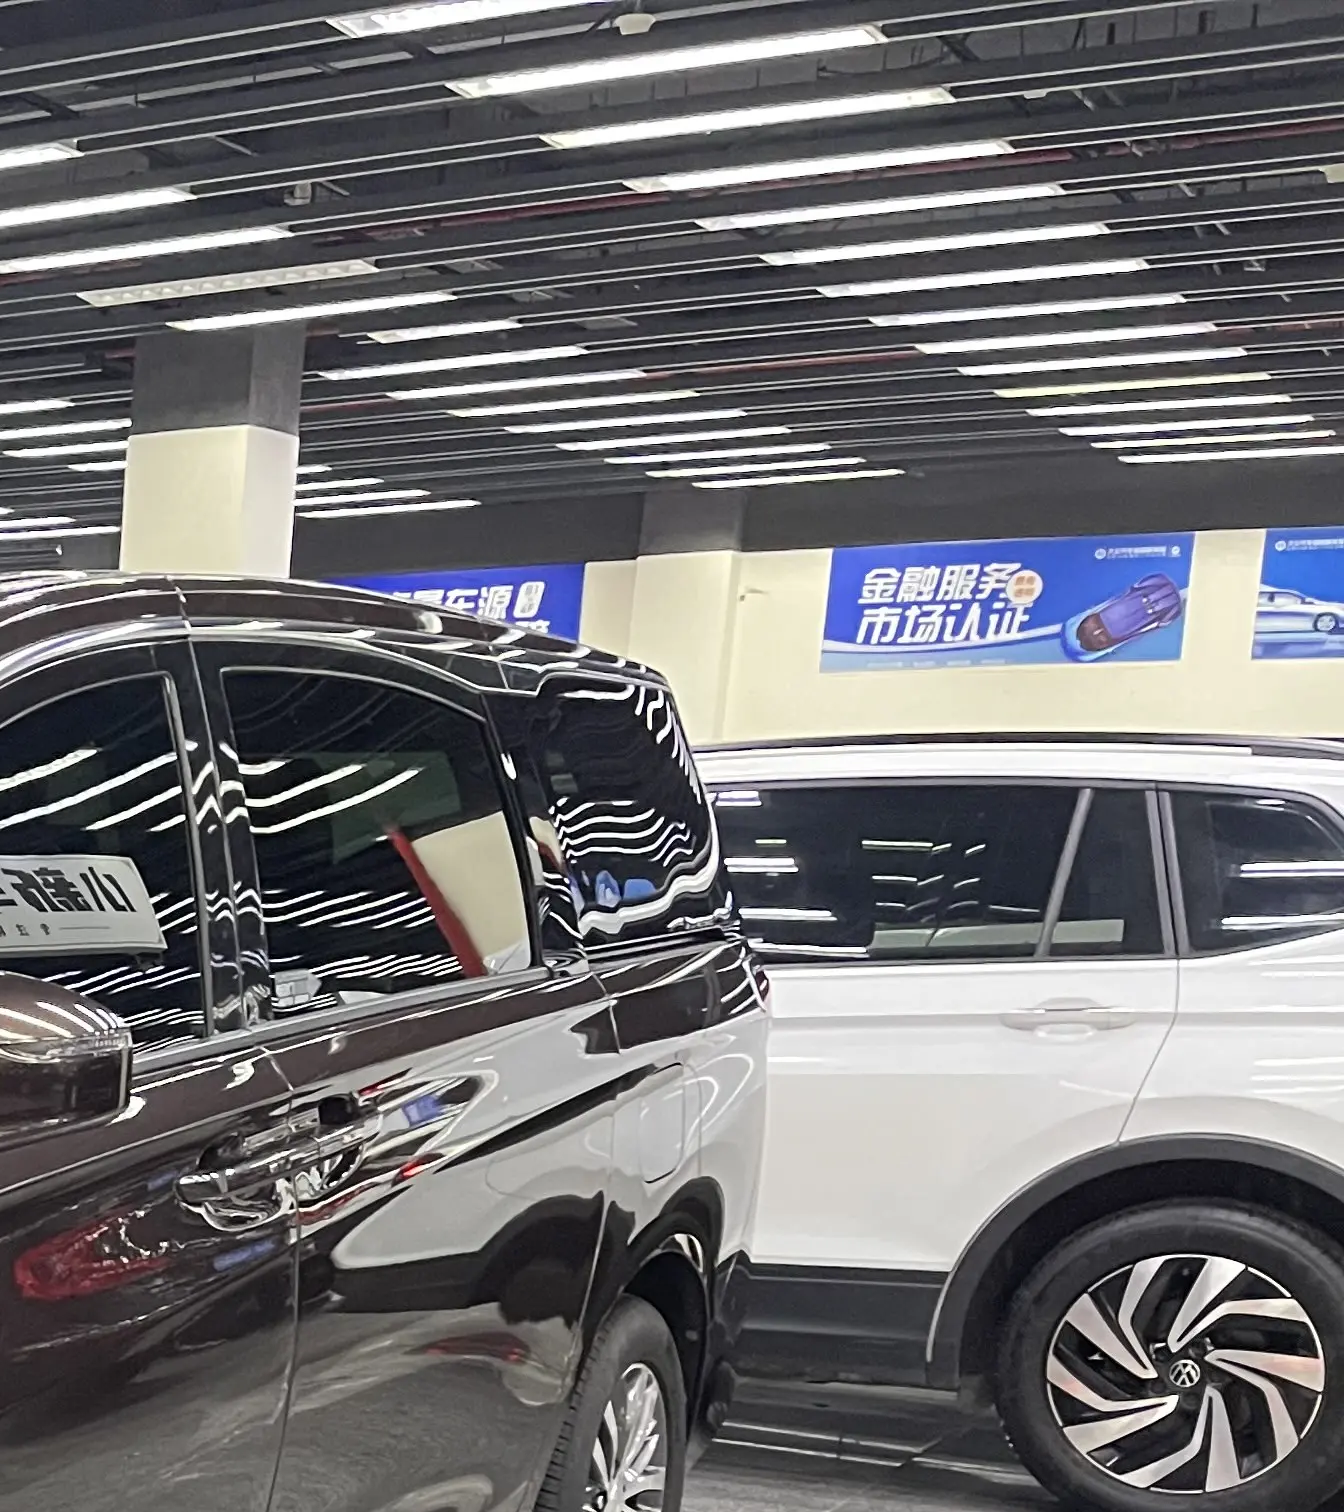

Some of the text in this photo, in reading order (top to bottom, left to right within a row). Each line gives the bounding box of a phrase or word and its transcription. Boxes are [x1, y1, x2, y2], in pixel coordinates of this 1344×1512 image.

[857, 563, 1022, 604] 金融服务
[856, 602, 1034, 645] 市场认证
